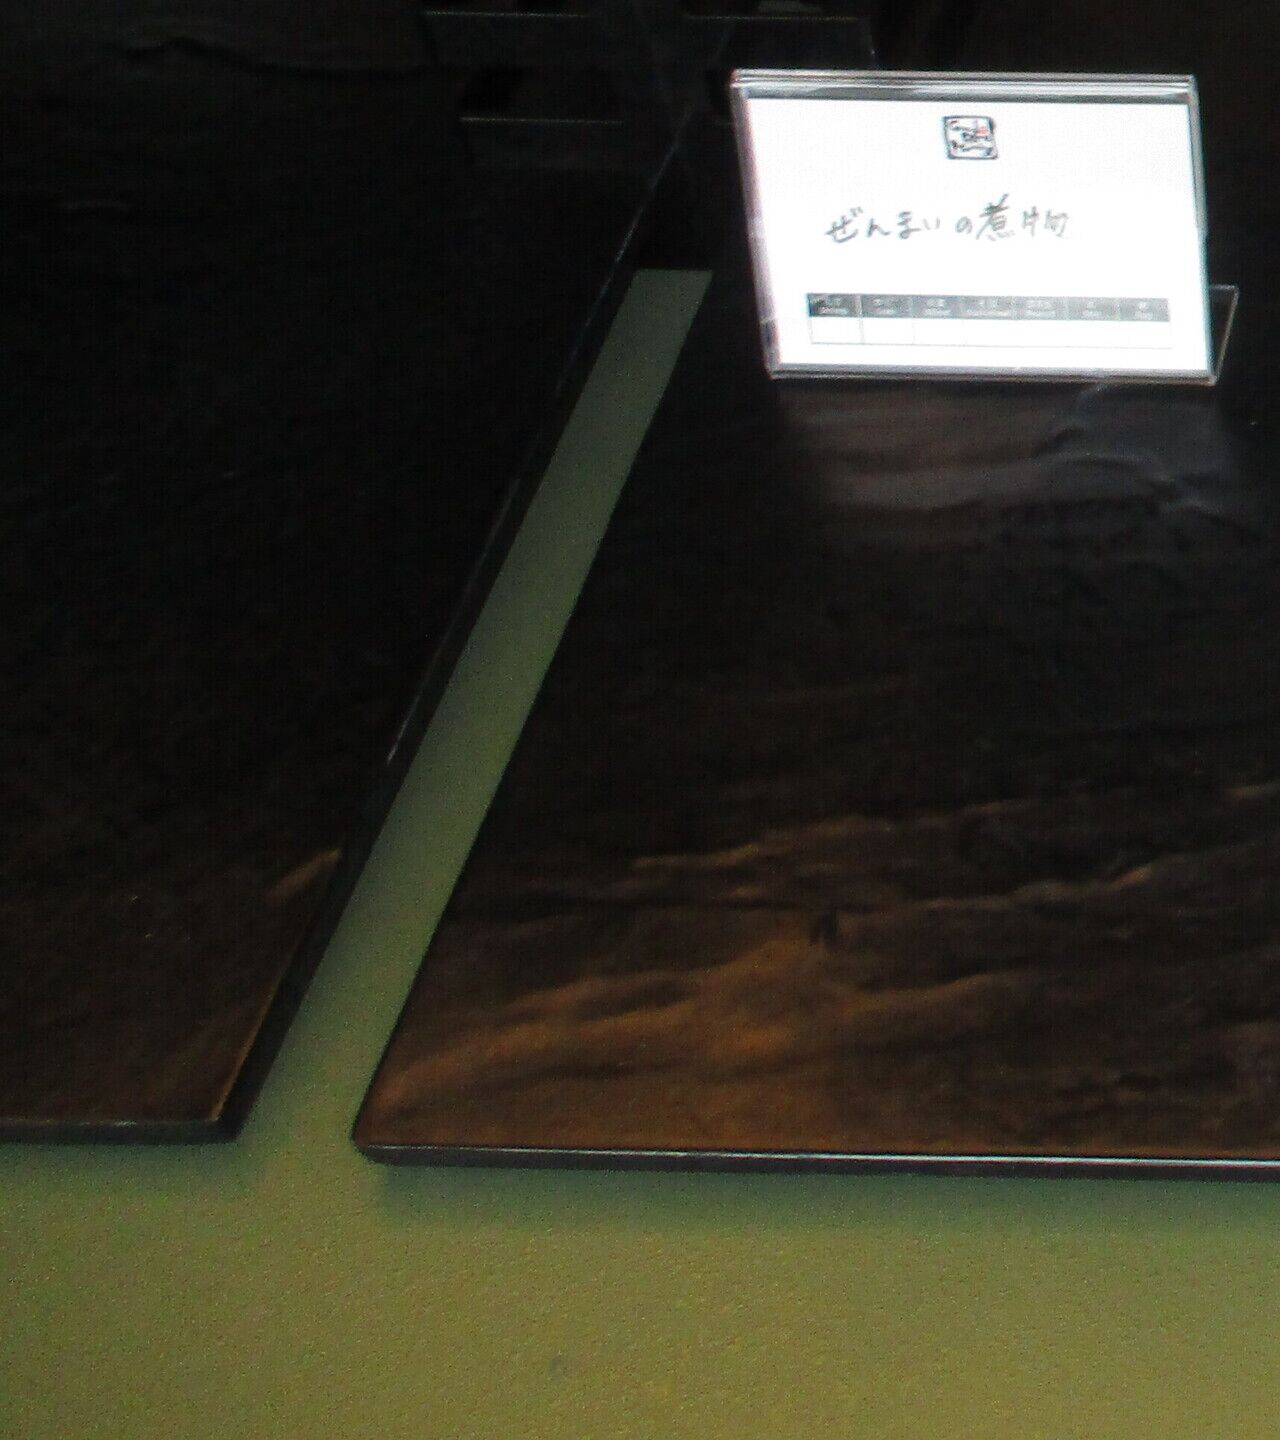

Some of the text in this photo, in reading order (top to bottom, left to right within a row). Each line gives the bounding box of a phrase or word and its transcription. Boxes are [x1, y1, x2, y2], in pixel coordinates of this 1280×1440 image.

[825, 192, 1070, 243] ぜんまいの煮物
